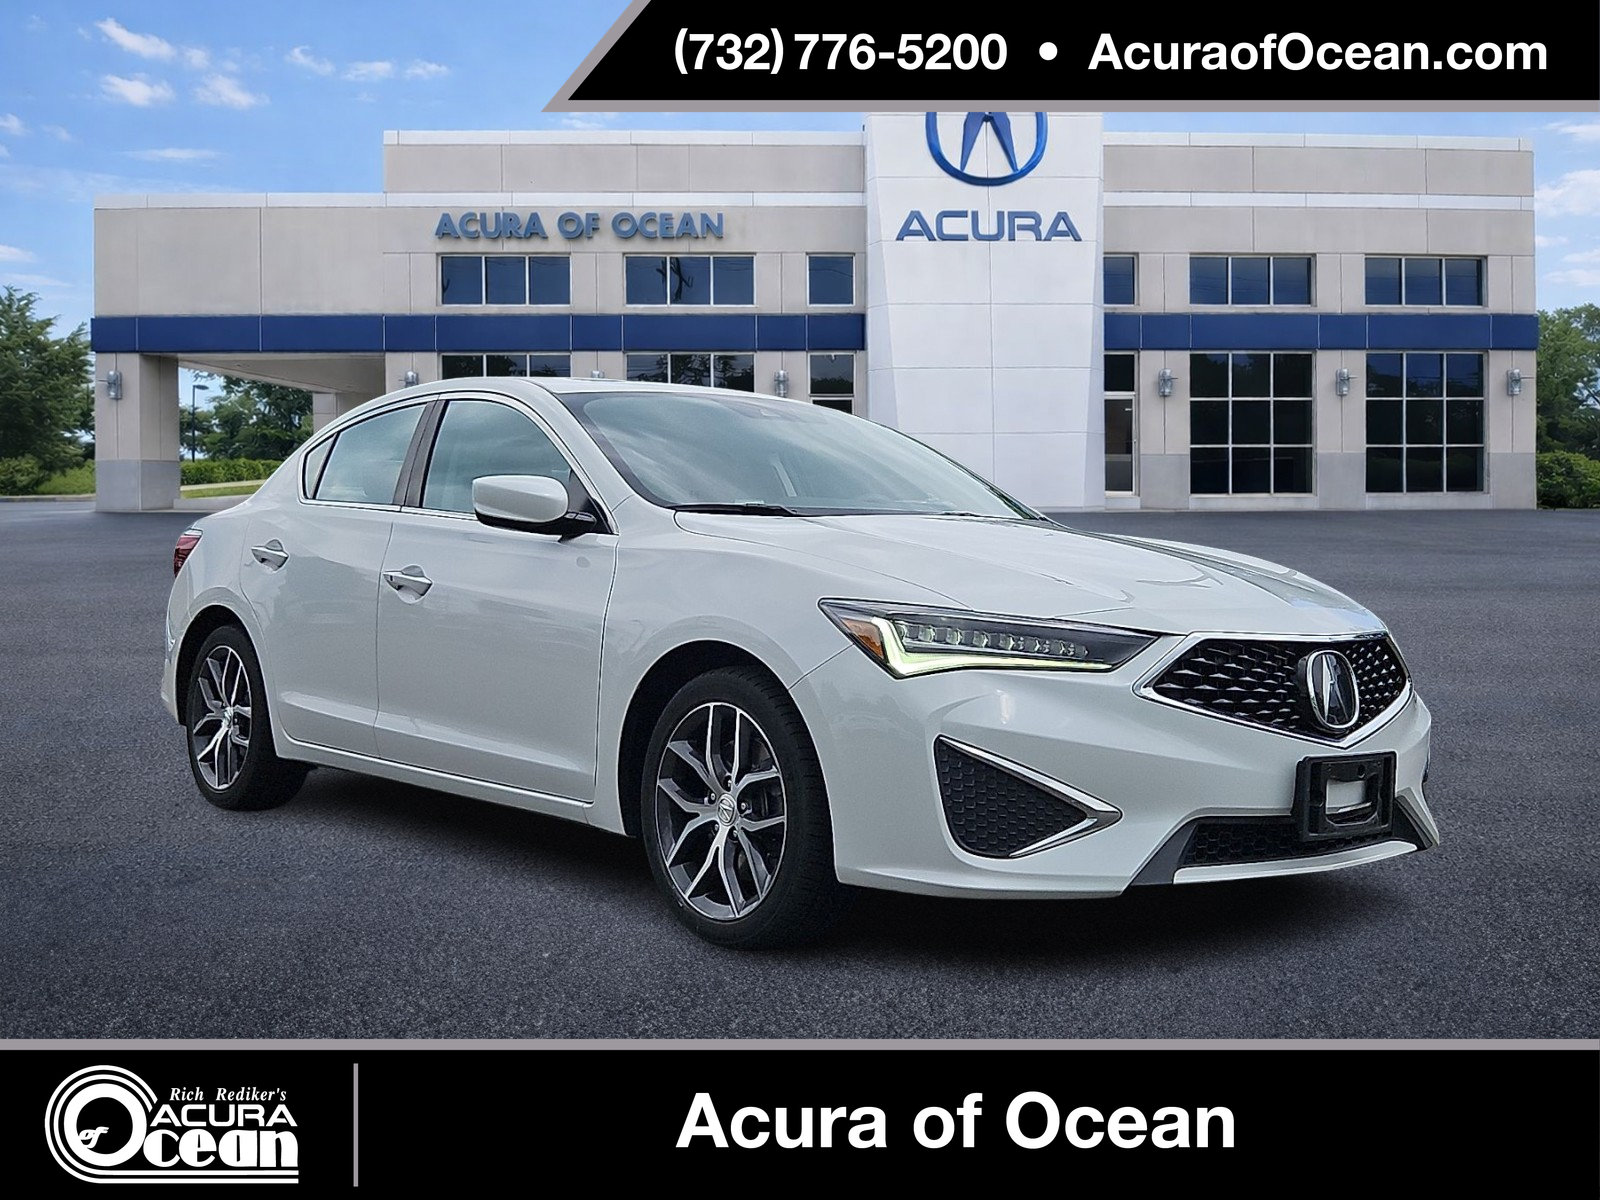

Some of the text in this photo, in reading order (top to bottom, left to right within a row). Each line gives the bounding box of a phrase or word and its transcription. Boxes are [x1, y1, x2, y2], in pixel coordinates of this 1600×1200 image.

[434, 211, 725, 239] ACURA OF OCEAN
[896, 210, 1082, 242] ACURA
